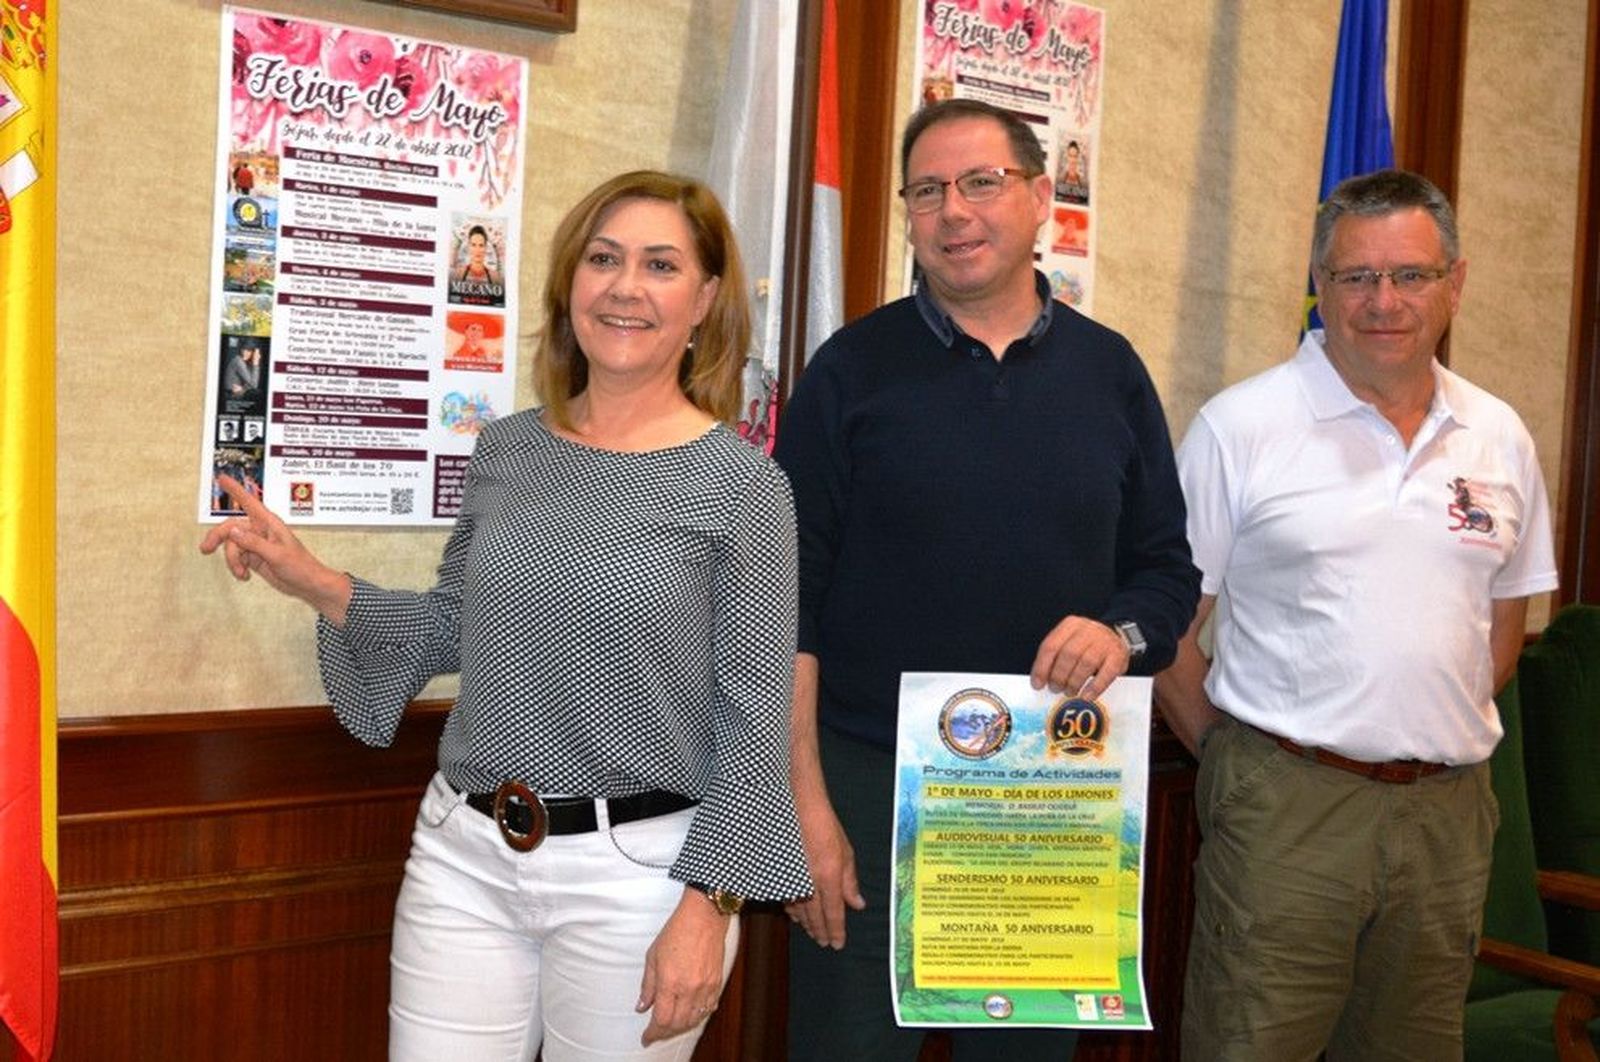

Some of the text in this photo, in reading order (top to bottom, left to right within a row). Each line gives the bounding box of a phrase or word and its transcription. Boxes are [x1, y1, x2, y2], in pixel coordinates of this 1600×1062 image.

[936, 6, 999, 49] Ferias
[1006, 24, 1025, 49] de
[1032, 28, 1089, 70] Mayo
[250, 57, 505, 139] Ferias de Mayo
[1058, 709, 1097, 738] 50
[922, 766, 1120, 780] Programa de Actividades
[941, 787, 954, 797] DE
[958, 788, 992, 797] MAYO
[1004, 788, 1022, 798] DÍA
[1026, 789, 1039, 798] DE
[1042, 789, 1062, 798] LOS
[1066, 789, 1114, 799] LIMONES
[936, 833, 1103, 844] AUDIOVISUAL 50 ANIVERSARIO
[936, 874, 1100, 884] SENDERISMO 50 ANIVERSARIO
[940, 923, 1094, 934] MONTAÑA 50 ANIVERSARIO
